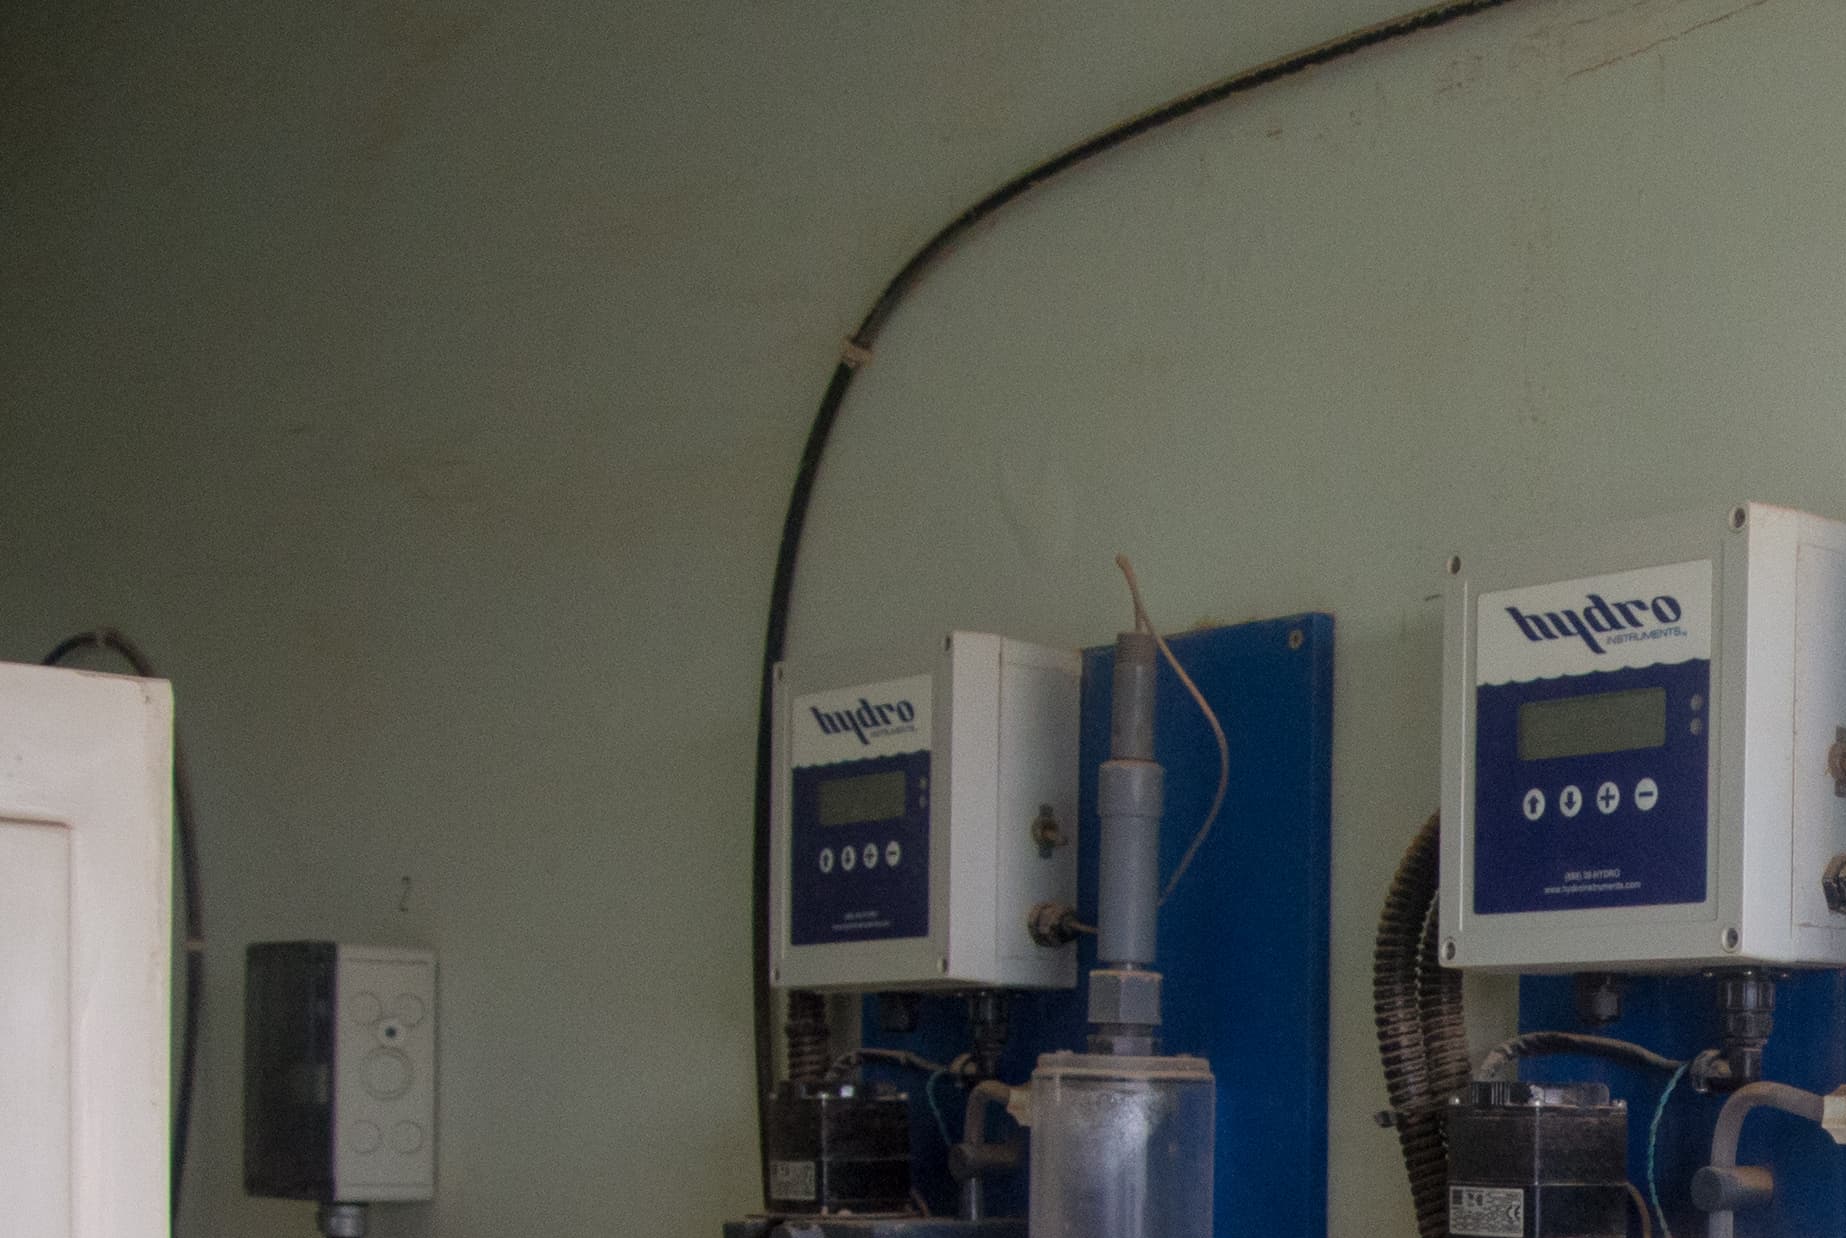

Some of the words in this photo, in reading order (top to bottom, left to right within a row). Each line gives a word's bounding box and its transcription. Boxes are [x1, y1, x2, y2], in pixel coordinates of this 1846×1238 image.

[1505, 594, 1682, 654] hydro
[1606, 626, 1682, 645] INSTRUMENTS
[809, 698, 915, 745] hydro
